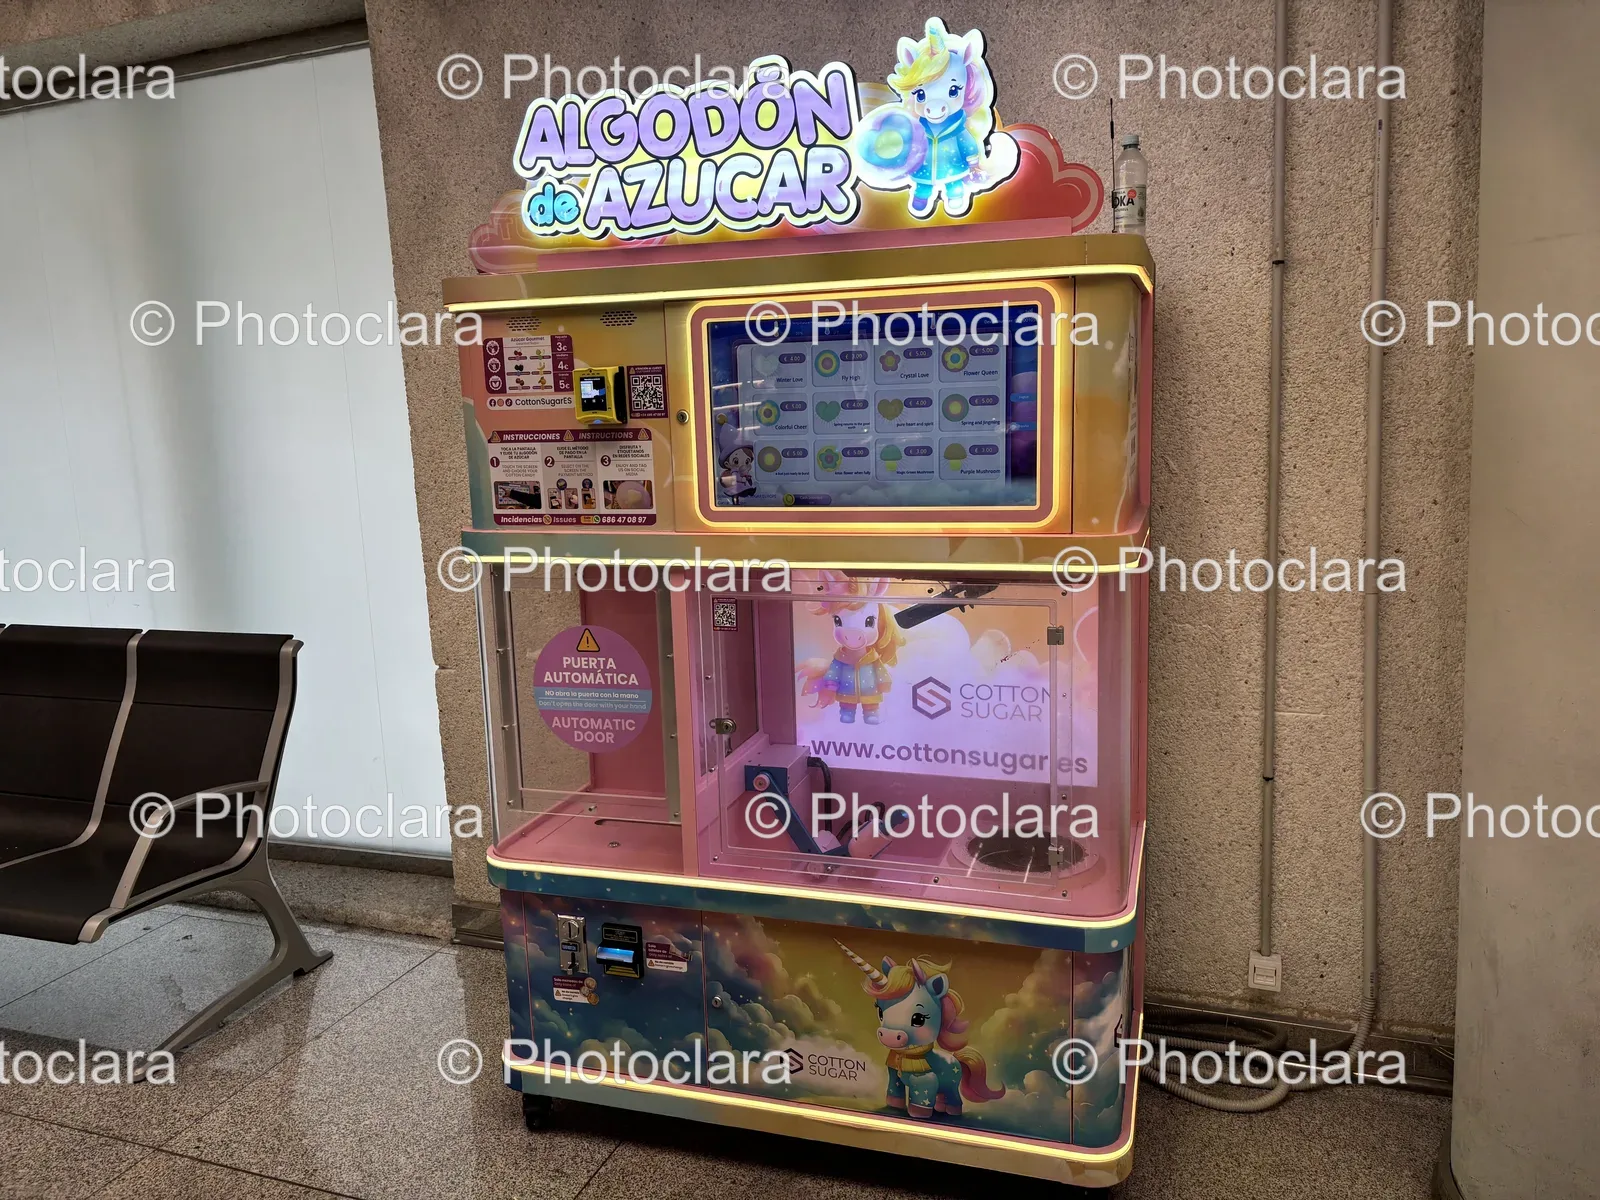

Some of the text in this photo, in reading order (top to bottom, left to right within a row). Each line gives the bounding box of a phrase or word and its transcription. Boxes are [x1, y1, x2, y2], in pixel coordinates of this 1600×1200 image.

[519, 62, 852, 170] ALGODÓN
[528, 145, 851, 228] de AZUCAR
[983, 369, 998, 377] Queen
[515, 396, 573, 408] CottonSugarES
[502, 433, 561, 441] INSTRUCCIONES
[578, 431, 634, 439] INSTRUCTIONS
[546, 457, 553, 467] 2
[603, 456, 609, 466] 3
[500, 516, 542, 524] Incidencias
[553, 516, 577, 524] Issues
[562, 656, 617, 670] PUERTA
[543, 669, 639, 686] AUTOMÁTICA
[578, 691, 599, 699] puerta
[959, 683, 1051, 704] COTTON
[960, 702, 1043, 722] SUGAR
[551, 716, 636, 731] AUTOMATIC
[574, 731, 615, 744] DOOR
[811, 740, 1088, 776] www.cottonsugares
[807, 1053, 867, 1072] COTTON
[808, 1066, 859, 1082] SUGAR
